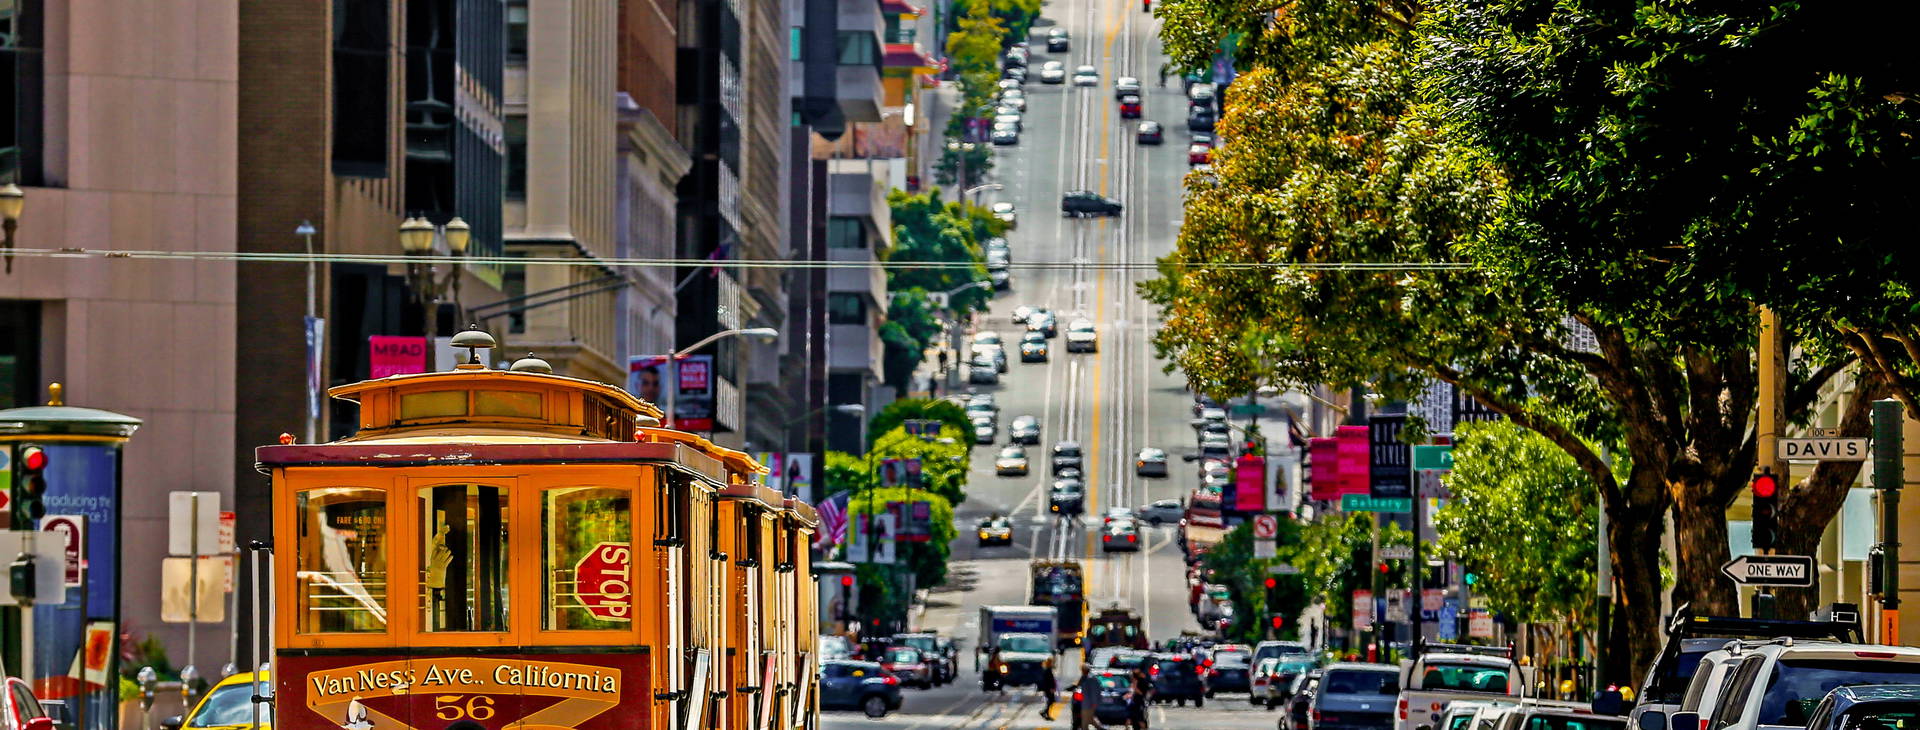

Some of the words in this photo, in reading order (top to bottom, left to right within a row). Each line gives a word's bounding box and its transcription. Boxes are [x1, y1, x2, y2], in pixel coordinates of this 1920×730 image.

[1787, 442, 1857, 456] DAVIS
[1351, 499, 1402, 510] Battery
[1747, 564, 1771, 576] ONE
[1776, 564, 1801, 577] WAY
[600, 546, 630, 617] STOP
[313, 675, 355, 696] Van
[357, 668, 416, 691] Ness
[494, 665, 616, 693] California
[435, 695, 495, 720] 56
